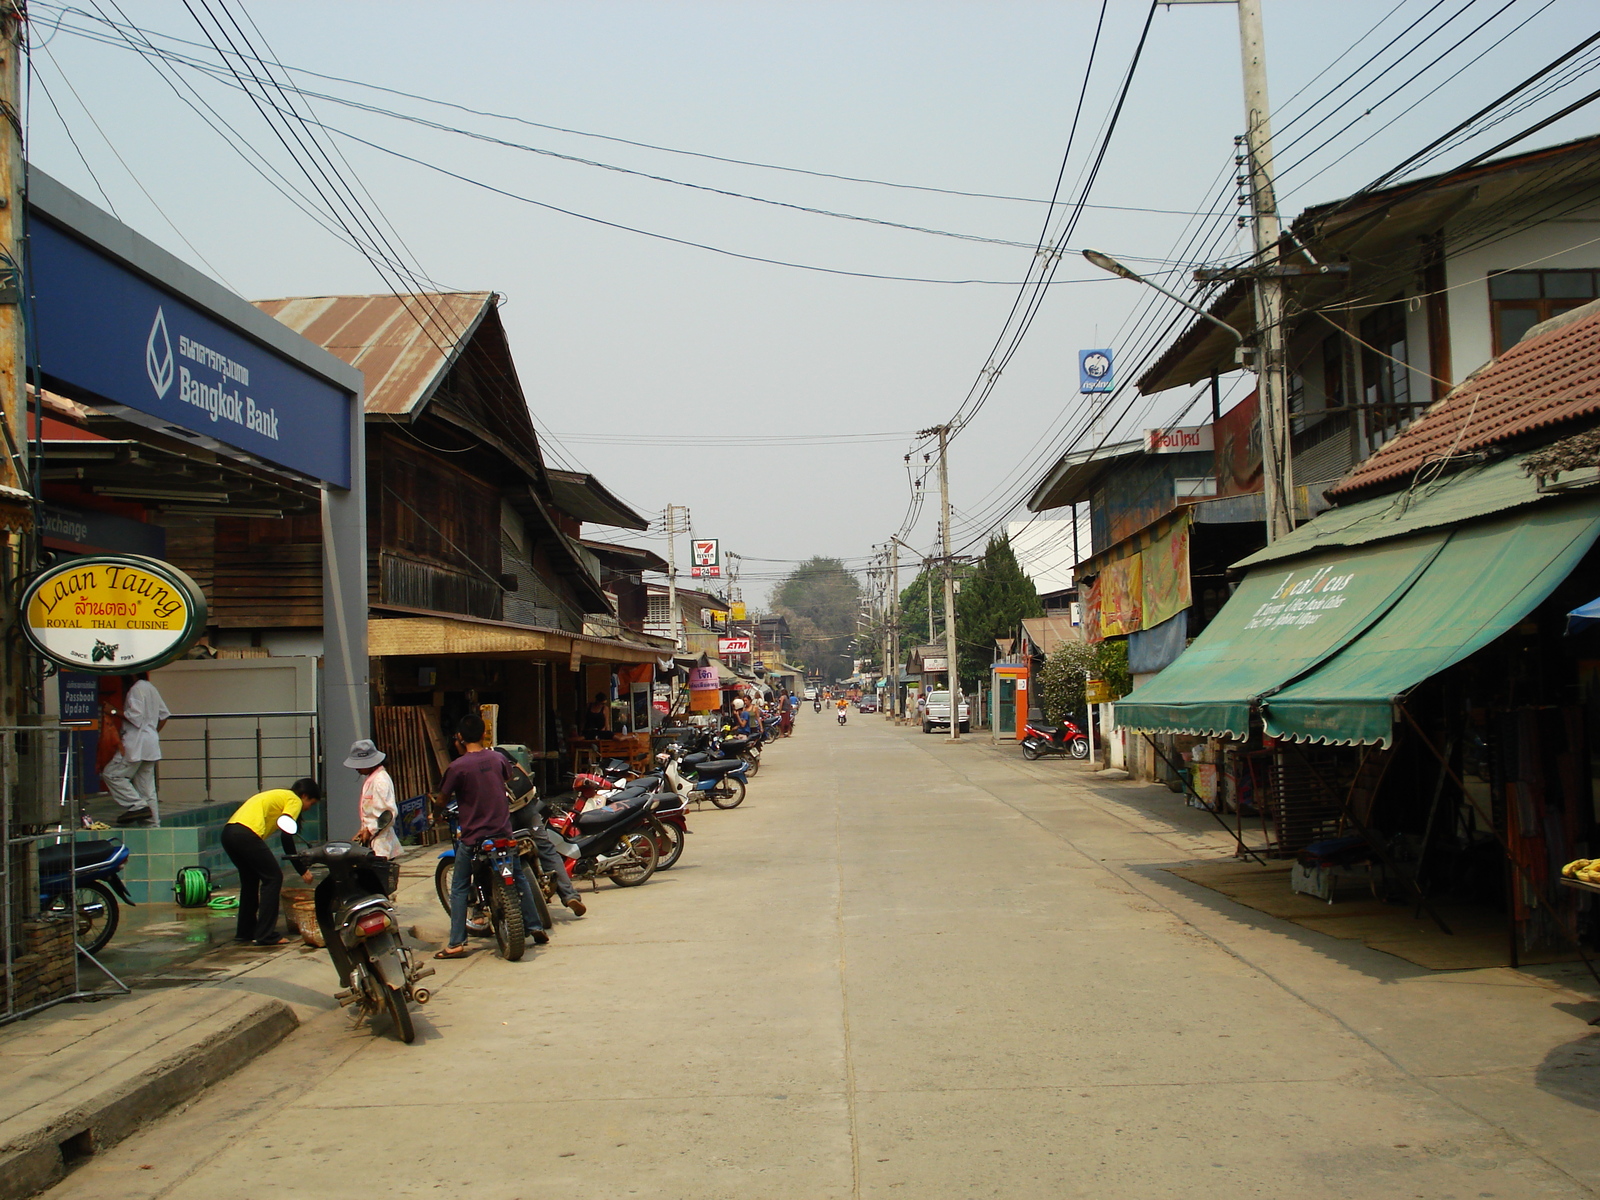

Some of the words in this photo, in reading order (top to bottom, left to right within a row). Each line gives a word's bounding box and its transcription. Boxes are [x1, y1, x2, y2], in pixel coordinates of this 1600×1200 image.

[179, 365, 244, 423] Bangkok
[246, 396, 279, 441] Bank
[702, 568, 710, 576] 24
[37, 571, 97, 616] Laan
[105, 566, 182, 619] Taung
[74, 596, 137, 616] ล้านตอง
[46, 619, 83, 629] ROYAL
[91, 619, 116, 629] THAI
[126, 620, 169, 630] CUISINE
[726, 641, 748, 650] ATM
[69, 649, 89, 660] SINCE
[120, 653, 134, 662] 1991
[65, 691, 95, 702] Passbook
[64, 703, 90, 716] Update
[401, 798, 423, 814] PEPSI
